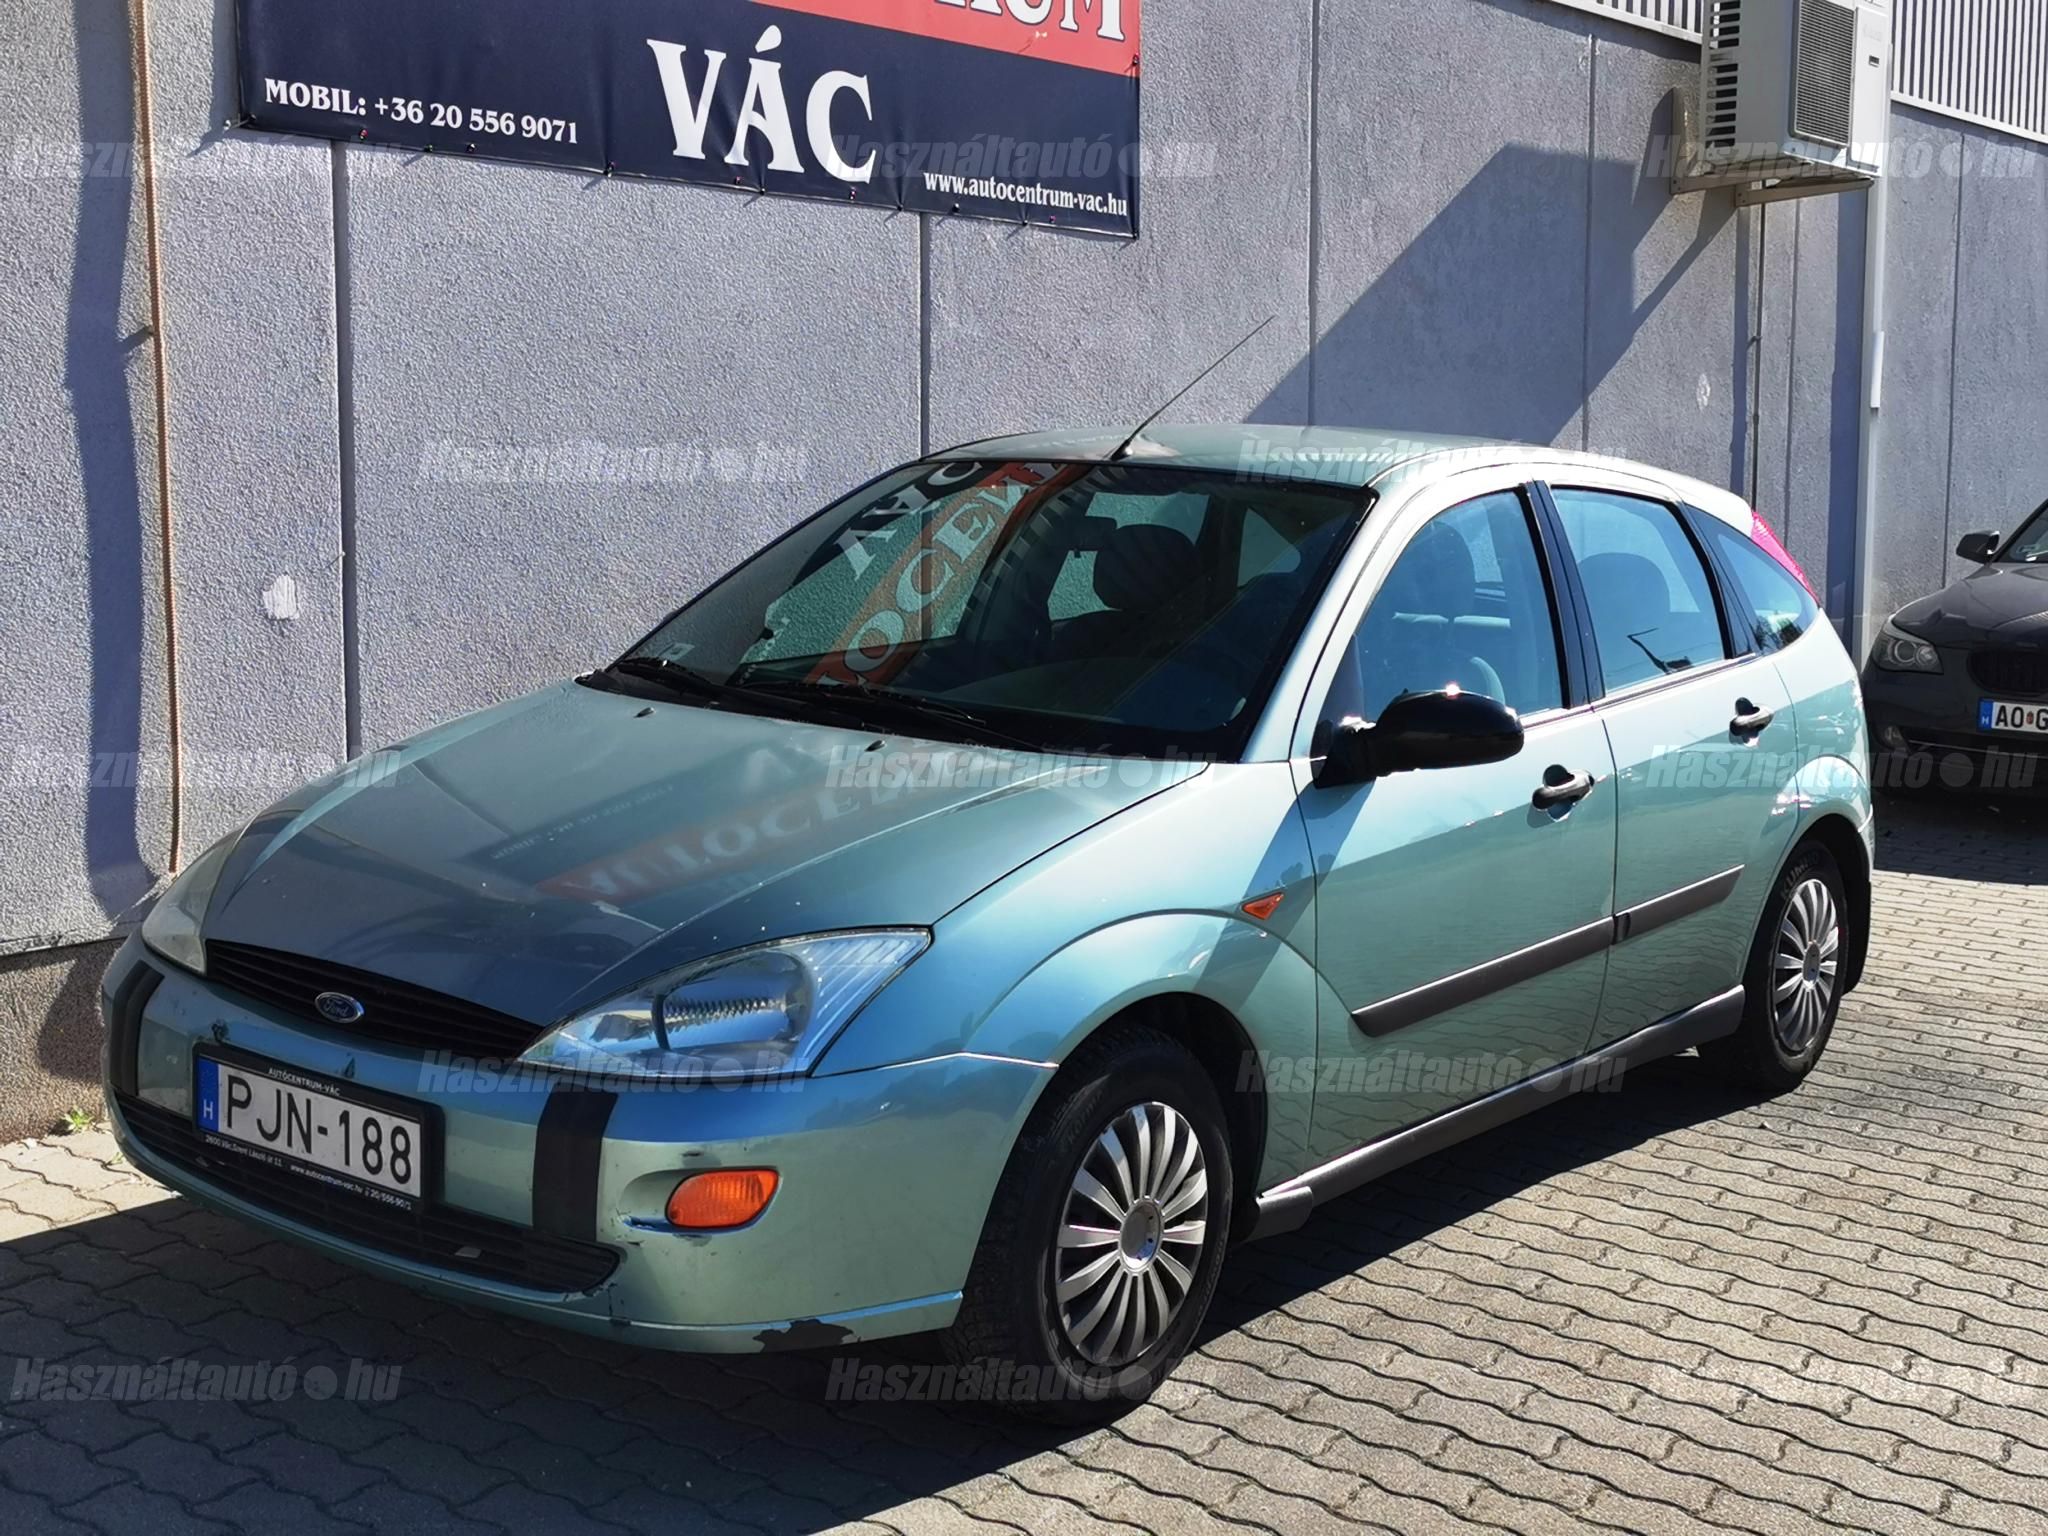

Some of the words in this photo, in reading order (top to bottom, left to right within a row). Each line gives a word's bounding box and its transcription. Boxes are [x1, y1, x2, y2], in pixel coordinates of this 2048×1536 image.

[264, 77, 366, 117] MOBIL:
[374, 96, 424, 124] +36
[430, 103, 463, 129] 20
[469, 108, 515, 135] 556
[521, 115, 577, 144] 9071
[646, 25, 877, 184] VÁC
[924, 172, 1128, 217] www.autocentrum-vac.hu
[1995, 705, 2025, 729] AO
[203, 1099, 214, 1121] H
[227, 1074, 412, 1185] PJN-188
